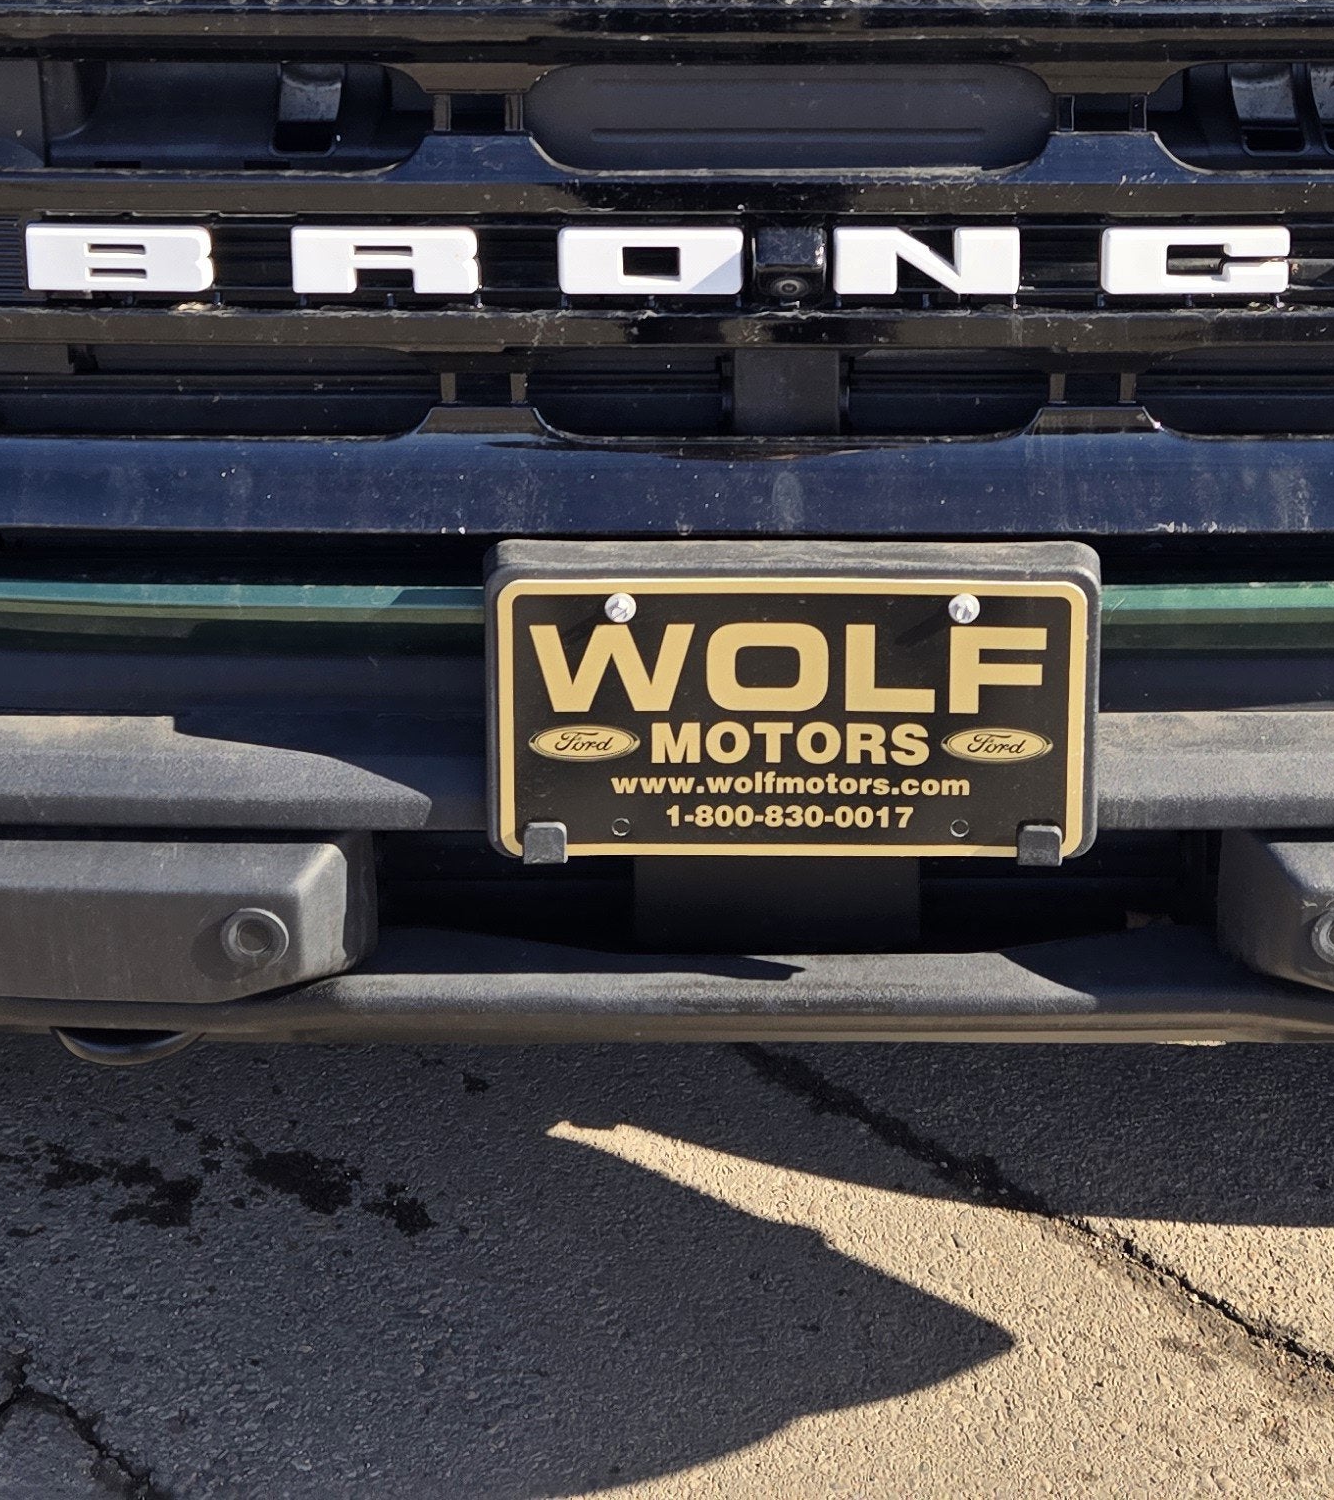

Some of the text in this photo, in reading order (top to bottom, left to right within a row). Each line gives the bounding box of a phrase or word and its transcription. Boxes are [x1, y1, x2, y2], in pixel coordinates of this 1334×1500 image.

[528, 621, 1049, 715] WOLF
[552, 728, 614, 755] Ford
[650, 720, 931, 767] MOTORS
[964, 731, 1028, 758] Ford
[611, 770, 972, 799] www.wolfmotors.com
[665, 804, 915, 830] 1-800-830-0017
